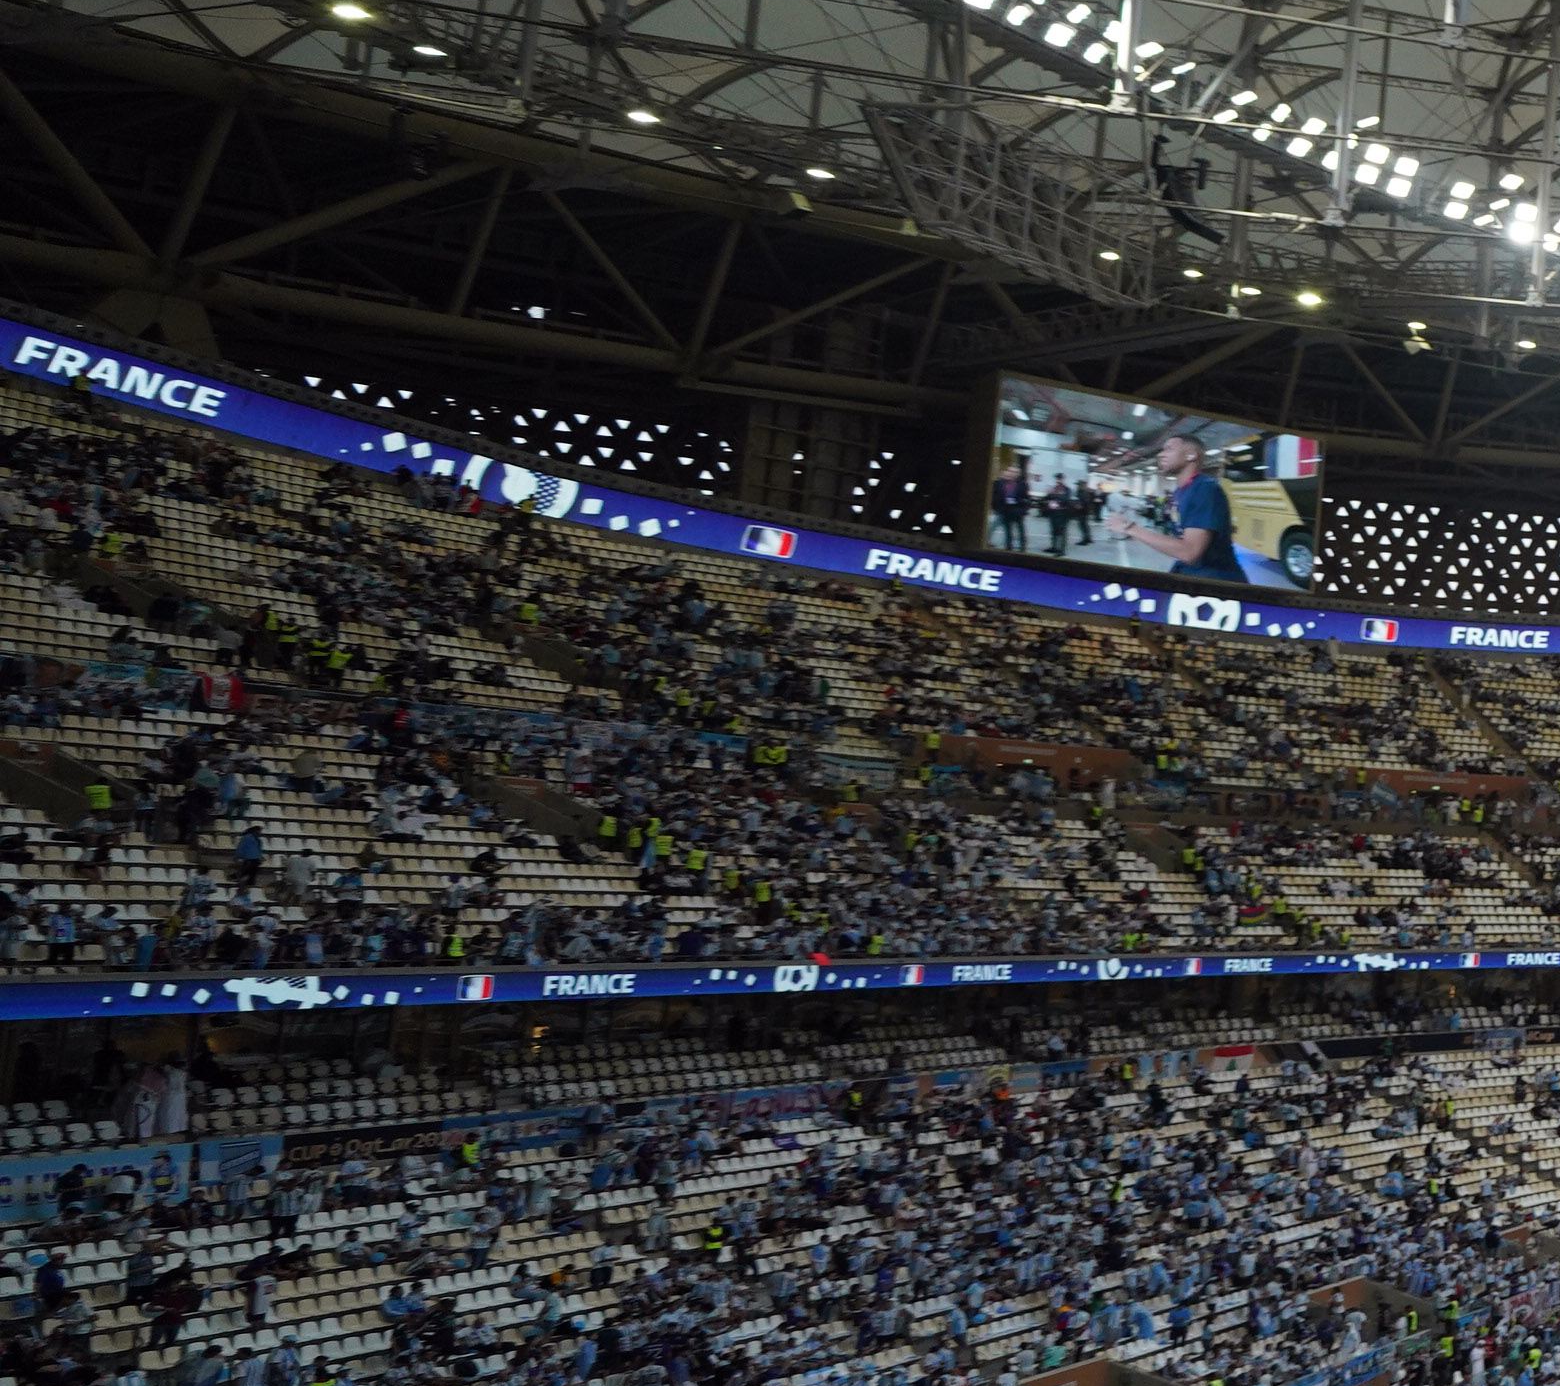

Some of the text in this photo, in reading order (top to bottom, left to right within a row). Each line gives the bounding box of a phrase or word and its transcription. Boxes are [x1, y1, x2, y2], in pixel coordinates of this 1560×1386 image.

[15, 337, 226, 416] FRANCE
[865, 549, 1002, 591] FRANCE
[1450, 627, 1549, 648] FRANCE
[1225, 958, 1272, 972] FRANCE
[1507, 953, 1560, 965] FRANCE
[953, 965, 1011, 981] FRANCE
[544, 974, 635, 995] FRANCE
